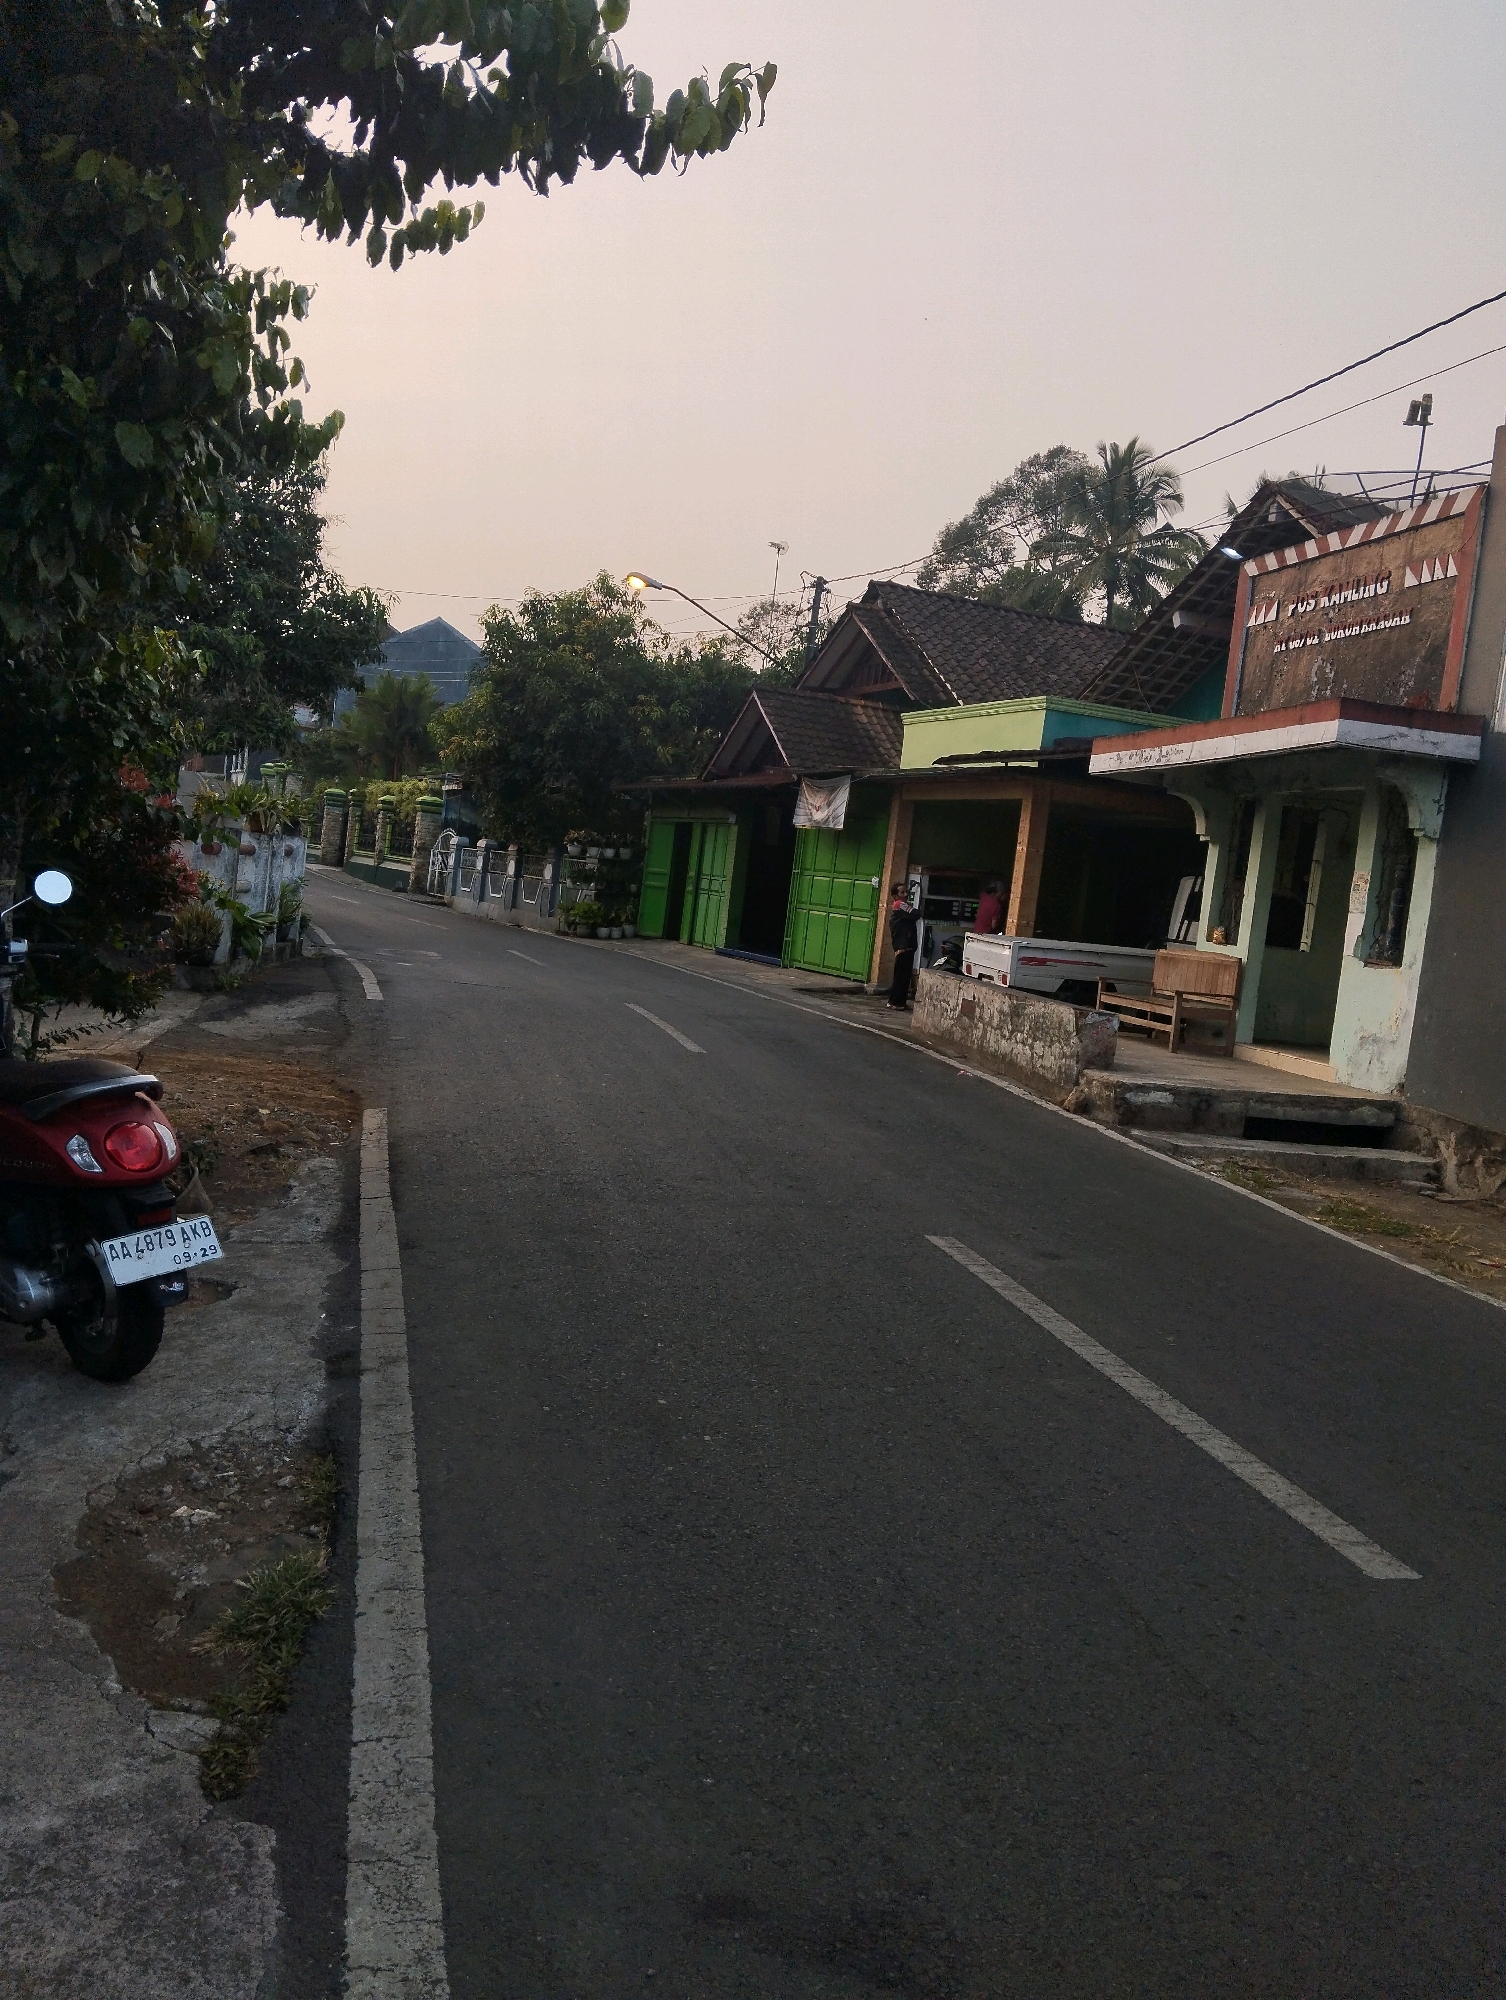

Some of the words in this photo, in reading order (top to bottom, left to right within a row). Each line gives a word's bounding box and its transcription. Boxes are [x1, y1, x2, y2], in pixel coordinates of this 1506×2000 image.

[1288, 591, 1318, 616] POS
[1320, 570, 1391, 608] KAMLING
[109, 1243, 132, 1261] AA
[136, 1229, 177, 1255] 4879
[181, 1220, 212, 1243] AKB
